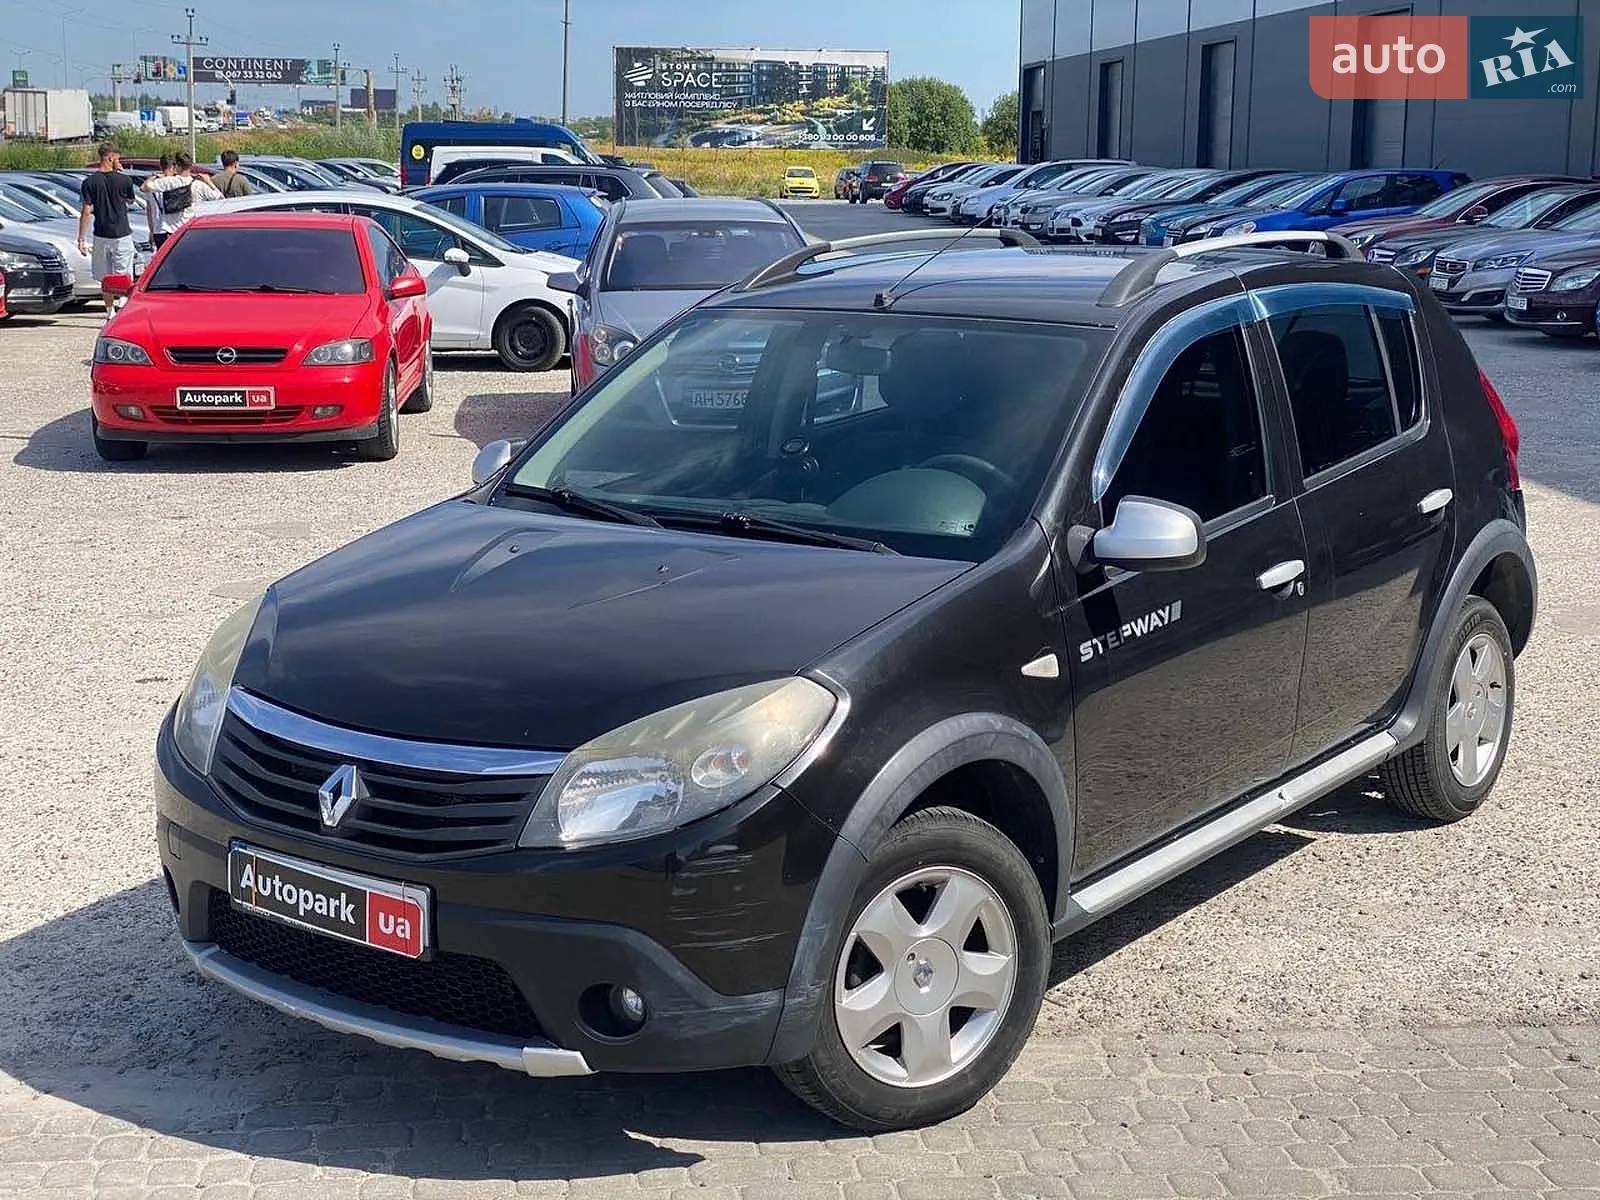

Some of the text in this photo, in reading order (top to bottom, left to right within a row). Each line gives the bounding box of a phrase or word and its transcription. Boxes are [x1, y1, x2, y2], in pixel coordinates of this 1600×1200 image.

[202, 58, 293, 71] CONTINENT
[661, 63, 698, 71] STONE
[661, 72, 723, 88] SPACE
[184, 392, 267, 406] Autopark ua
[1079, 604, 1171, 663] STEPWAY
[240, 863, 411, 940] Autopark ua
